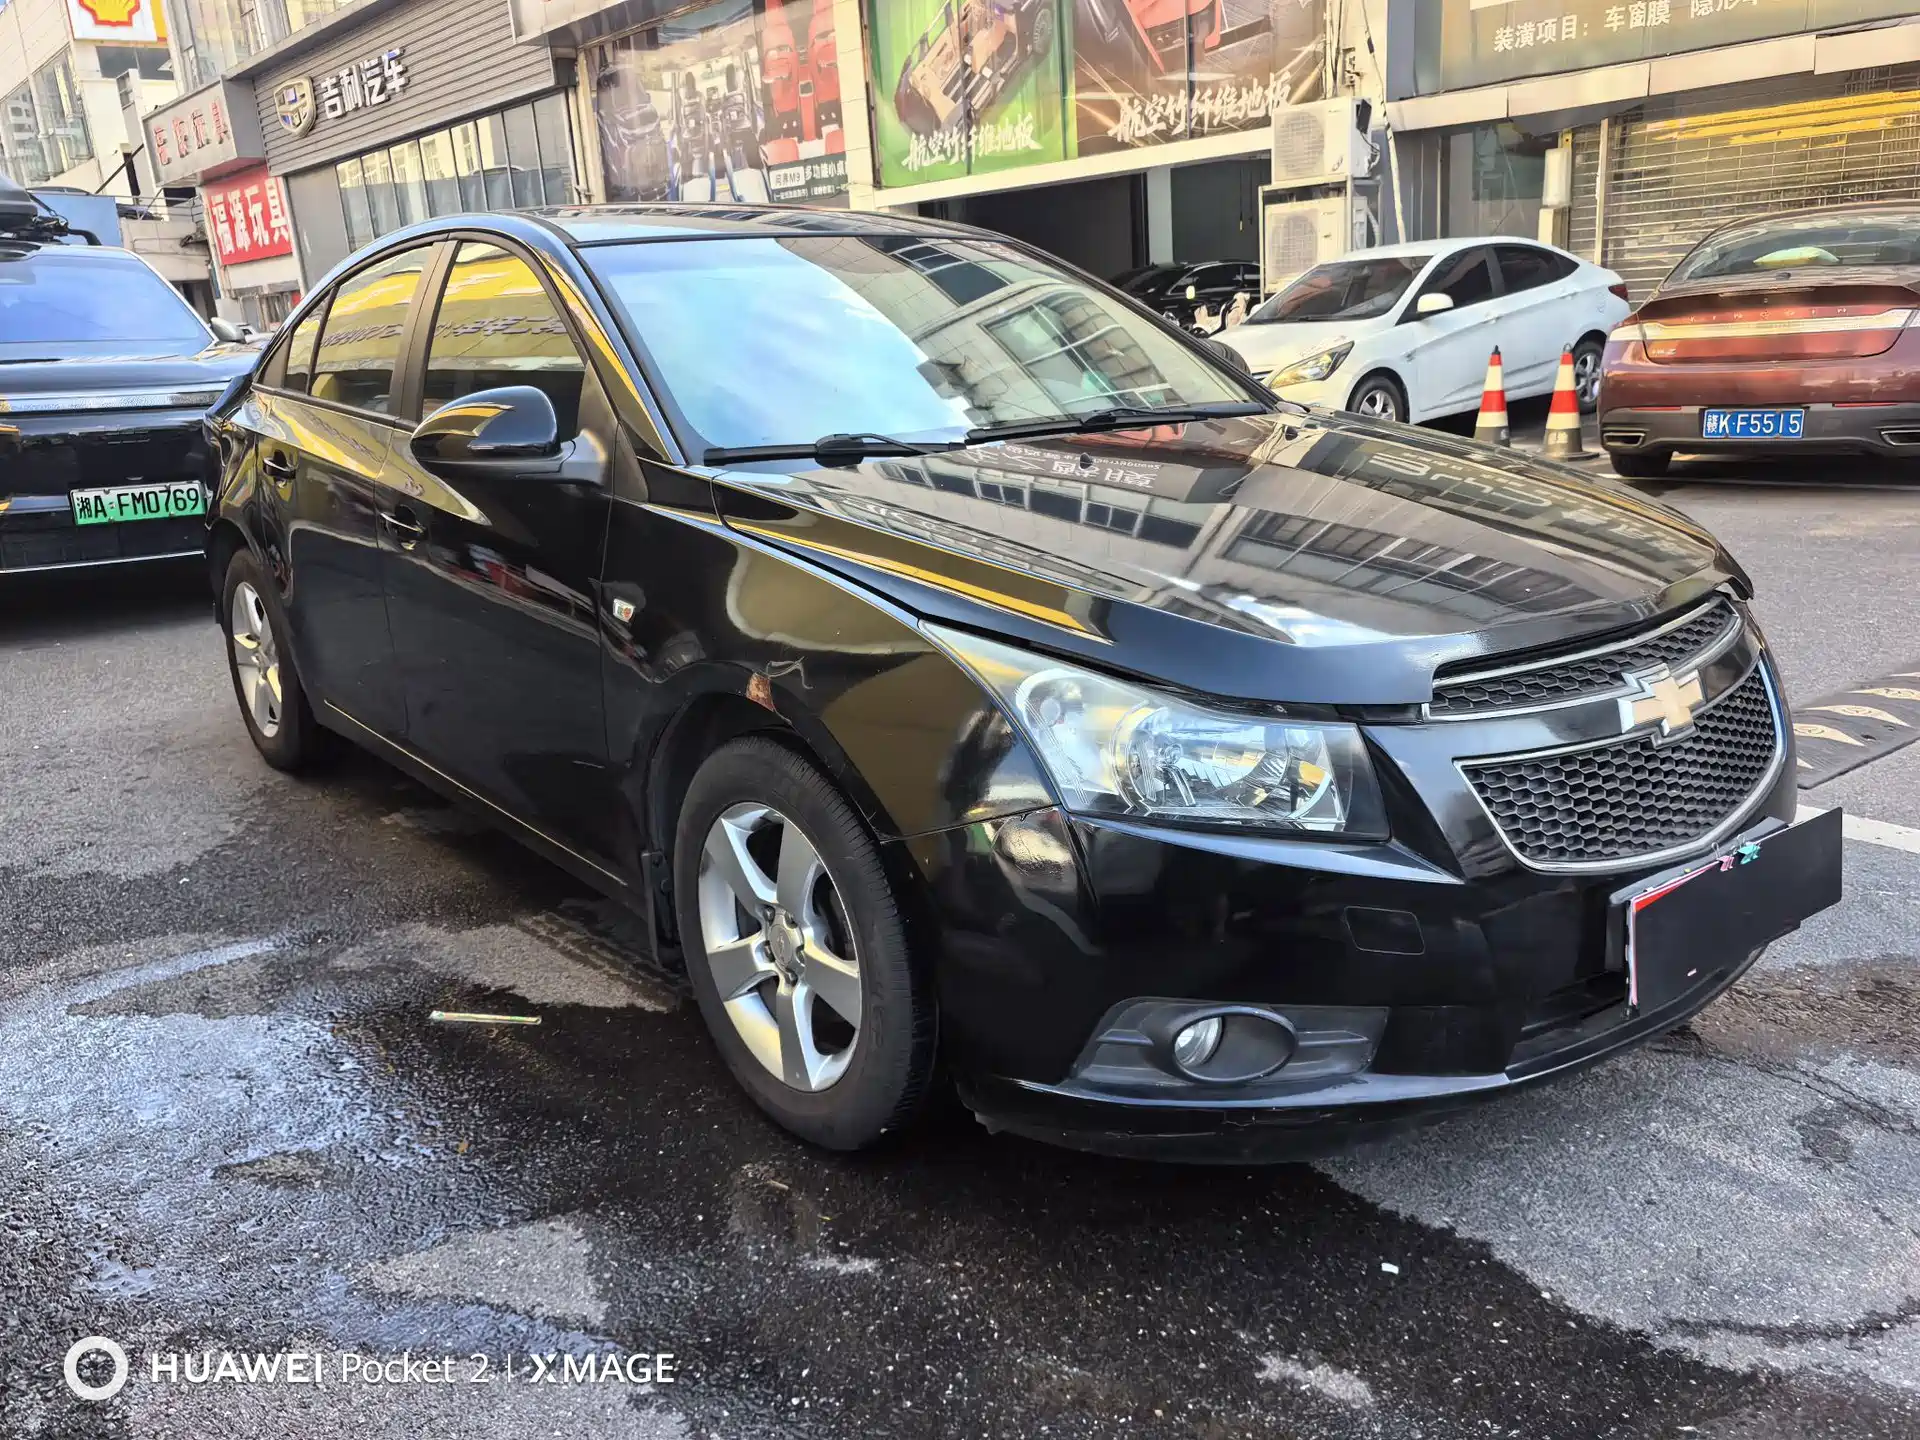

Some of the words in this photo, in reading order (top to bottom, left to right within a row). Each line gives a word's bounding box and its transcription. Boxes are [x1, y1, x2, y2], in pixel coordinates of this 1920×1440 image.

[1604, 0, 1672, 33] 车窗膜
[320, 47, 407, 119] 吉利汽车
[1107, 70, 1292, 143] 航空竹纤维地板
[900, 111, 1045, 172] 航空竹纤维地板
[210, 178, 290, 256] 福源玩具
